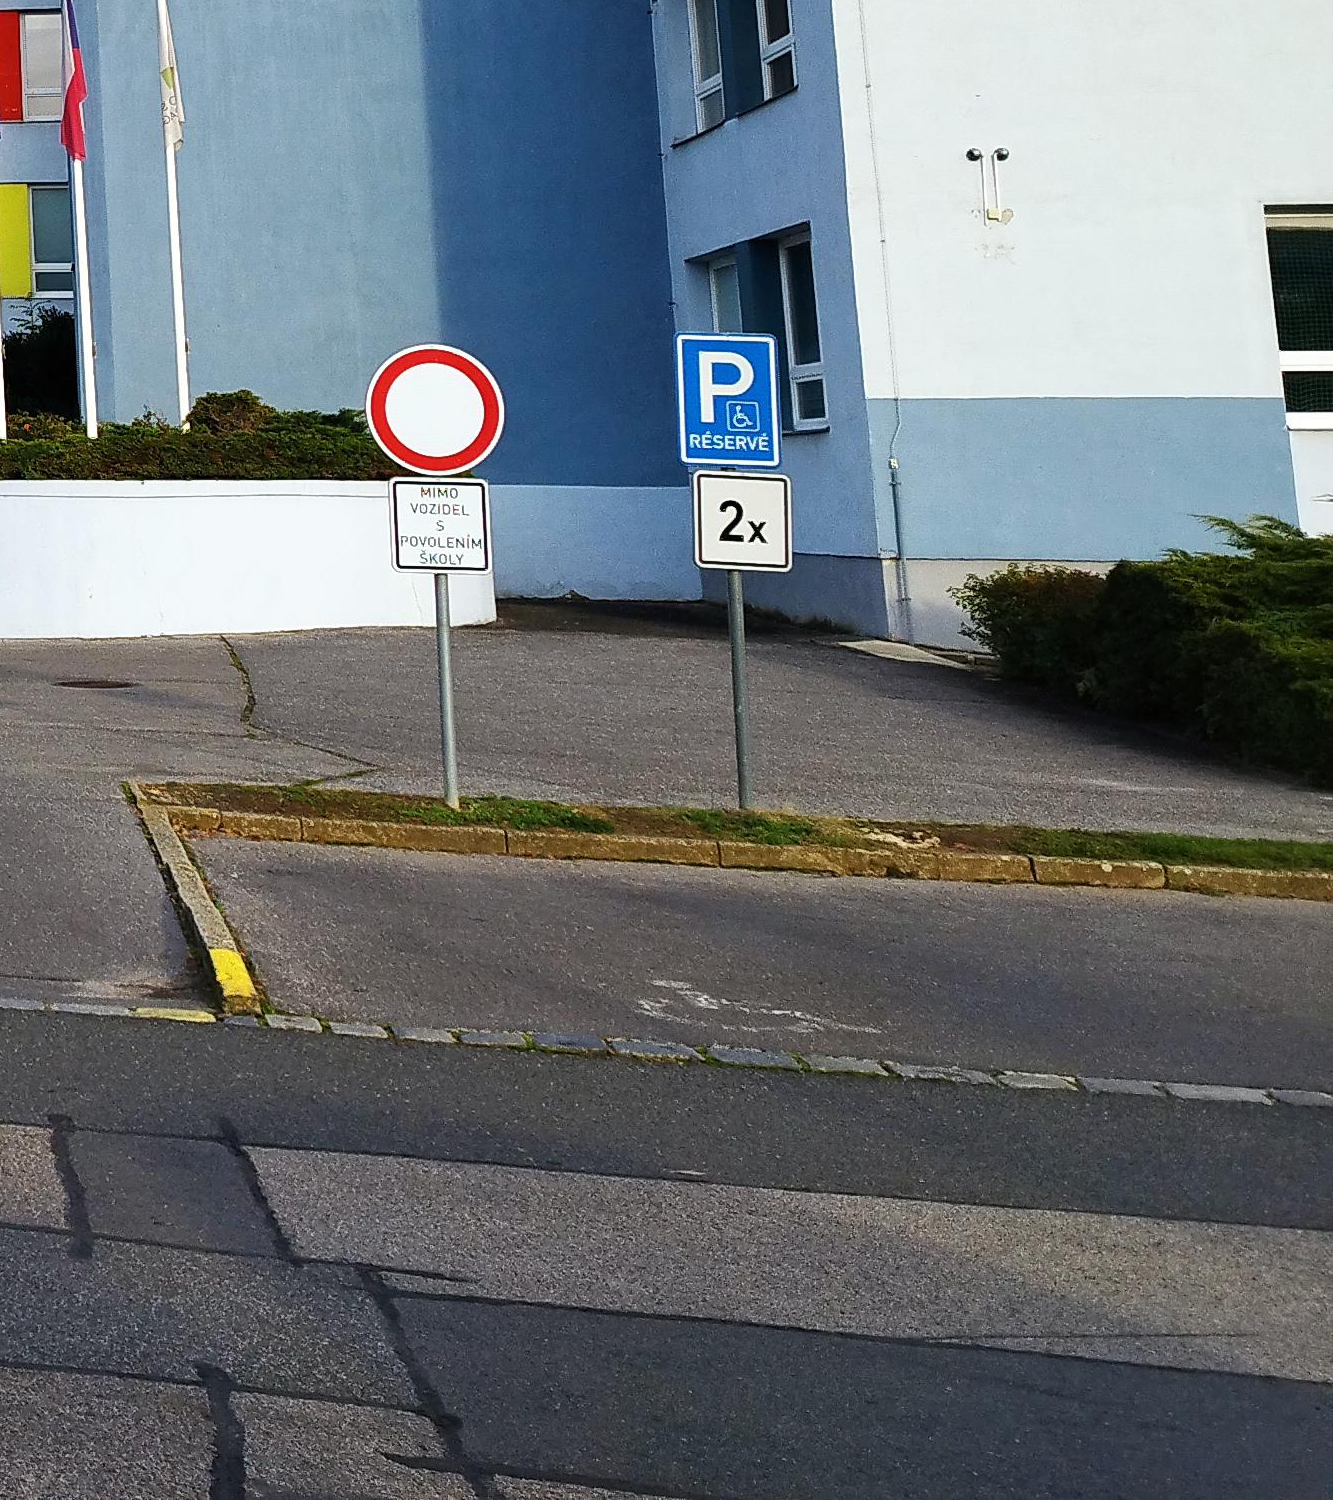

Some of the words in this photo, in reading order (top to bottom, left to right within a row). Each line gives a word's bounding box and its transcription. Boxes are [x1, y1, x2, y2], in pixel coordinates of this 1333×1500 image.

[698, 350, 755, 424] P
[689, 431, 769, 452] RÉSERVÉ
[420, 486, 459, 499] MIMO
[410, 502, 470, 516] VOZIDEL
[435, 519, 445, 532] S
[718, 499, 768, 545] 2x
[400, 533, 482, 550] POVOLENÍM
[419, 550, 464, 566] ŠKOLY
